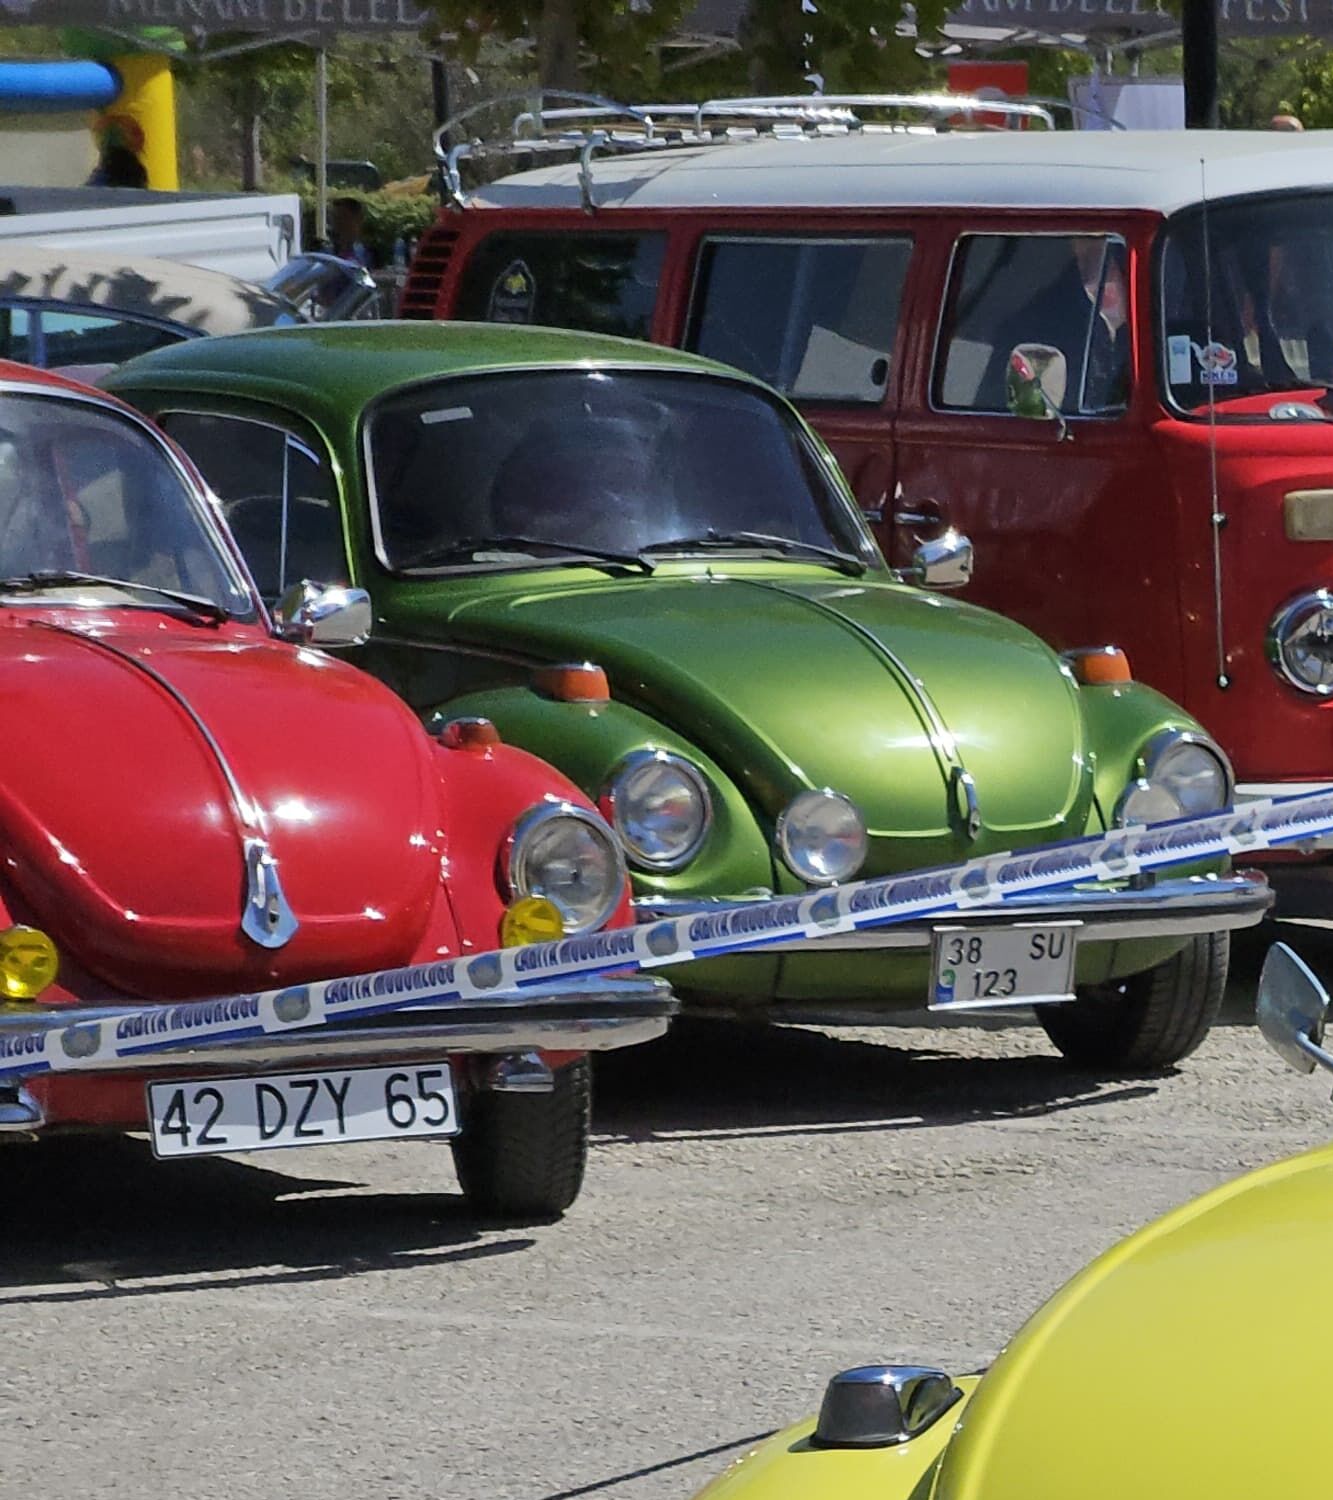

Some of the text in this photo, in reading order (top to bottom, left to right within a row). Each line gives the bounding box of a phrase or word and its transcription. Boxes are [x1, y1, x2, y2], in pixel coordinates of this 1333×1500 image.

[948, 932, 1066, 966] 38 SU
[973, 968, 1018, 997] 123
[160, 1069, 449, 1147] 42 DZY 65
